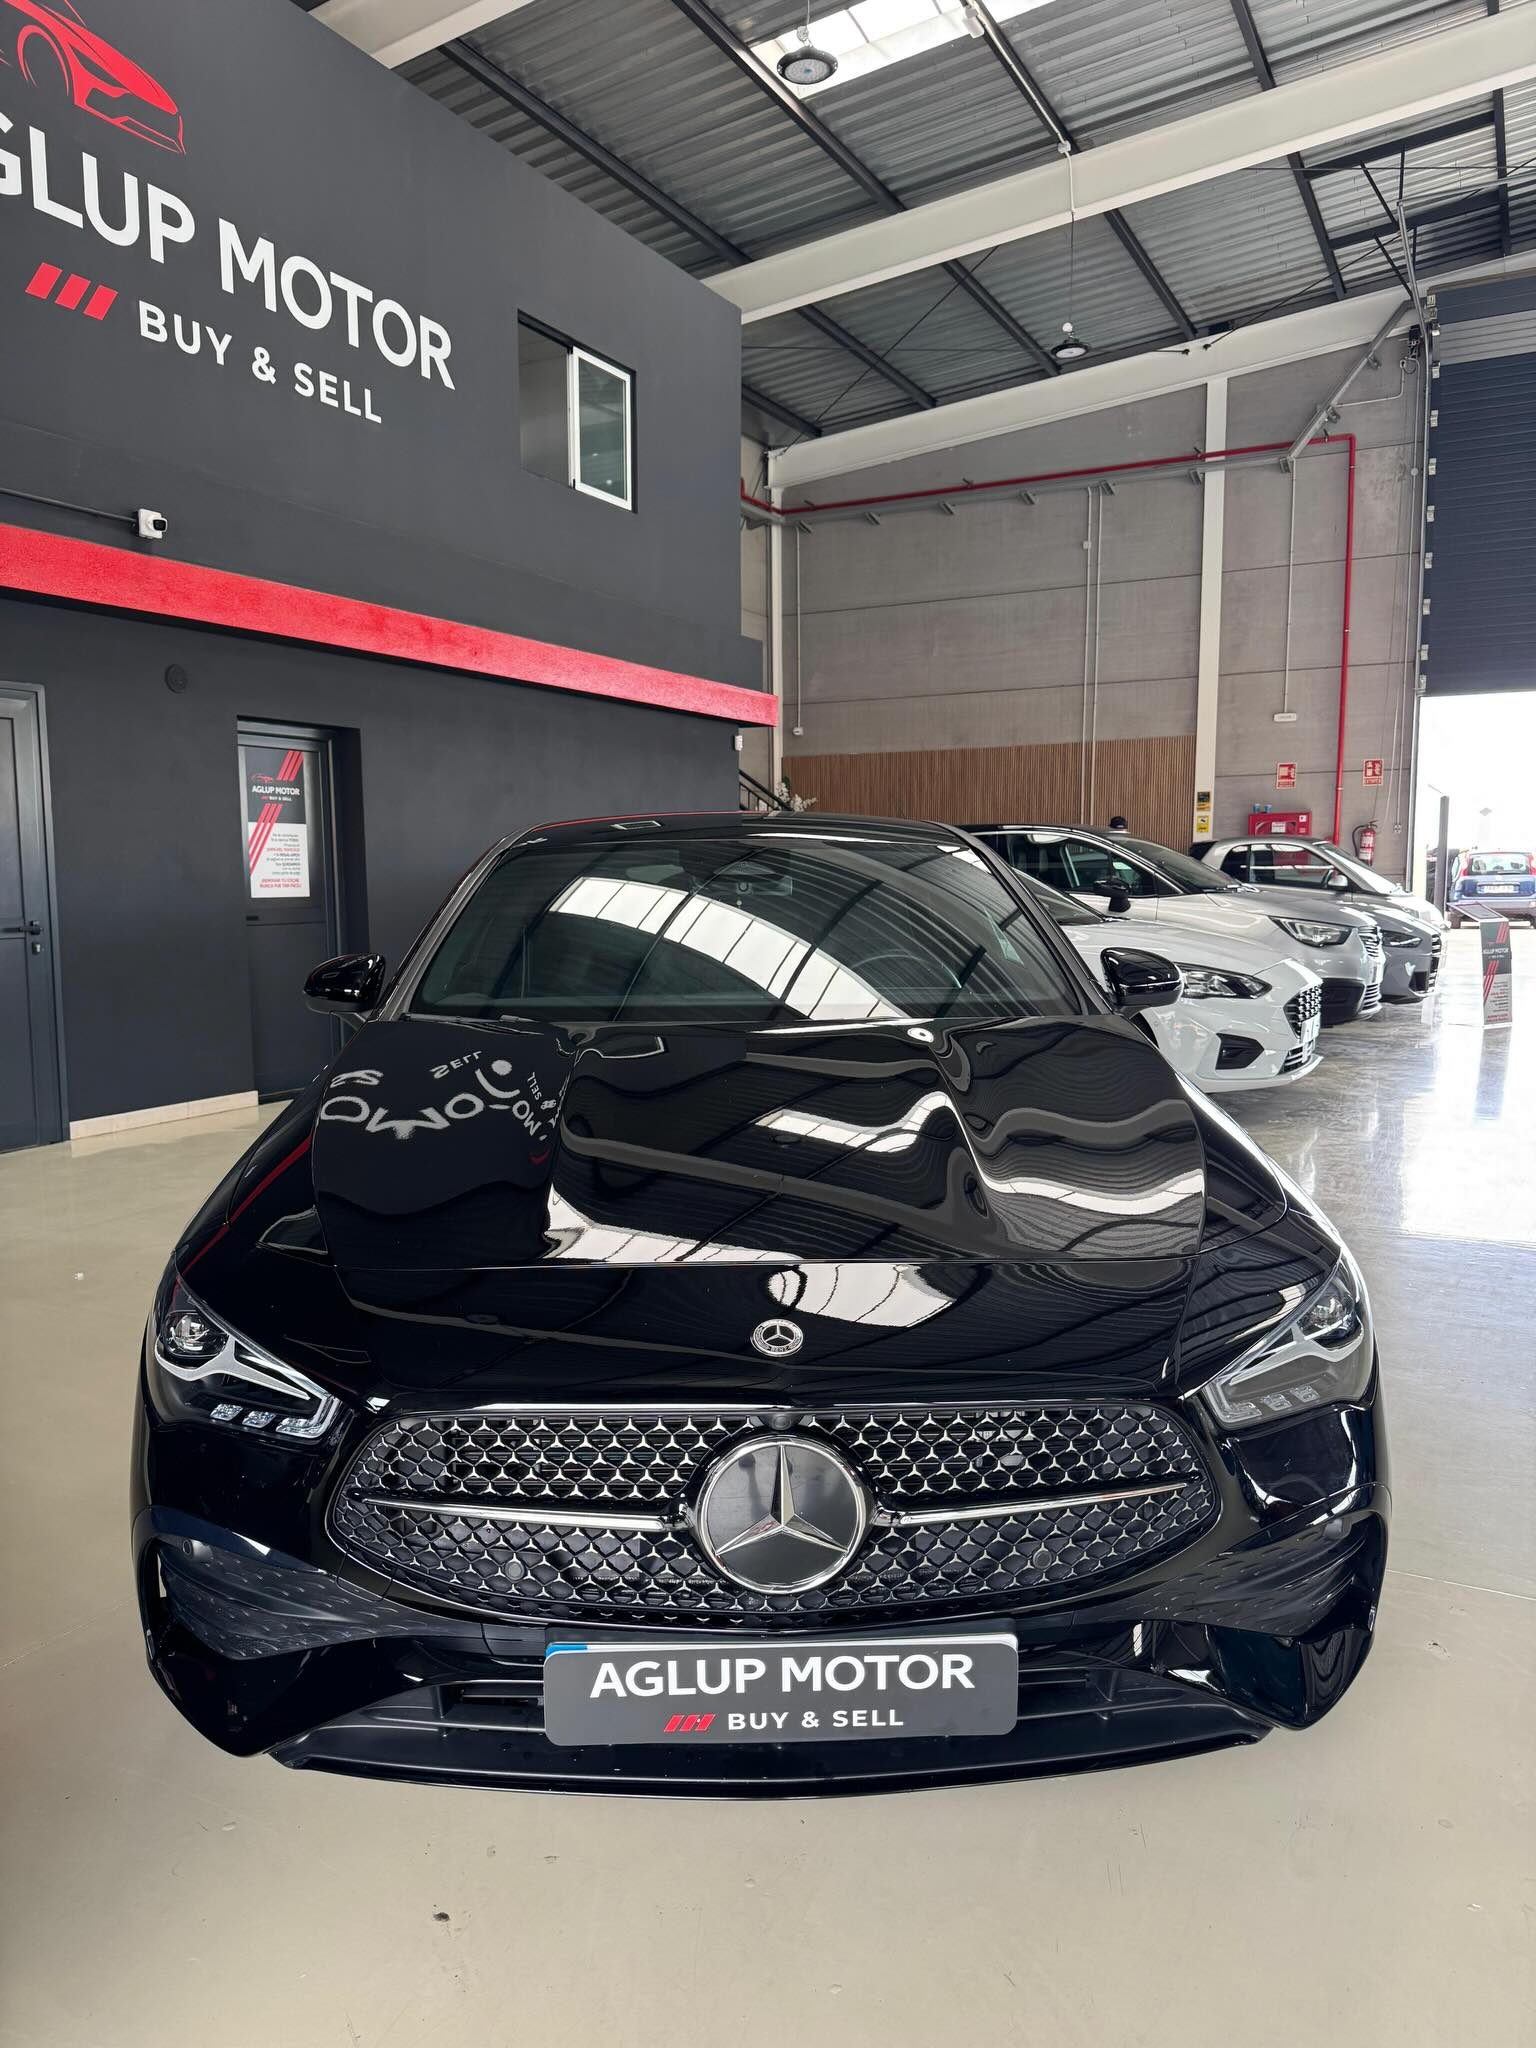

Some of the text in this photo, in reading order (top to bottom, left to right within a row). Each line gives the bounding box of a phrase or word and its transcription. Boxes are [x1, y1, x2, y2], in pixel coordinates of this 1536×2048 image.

[218, 217, 456, 391] MOTOR
[138, 299, 382, 424] BUY & SELL
[252, 785, 300, 795] AGLUP MOTOR
[589, 1653, 976, 1699] AGLUP MOTOR
[727, 1708, 905, 1731] BUY & SELL
